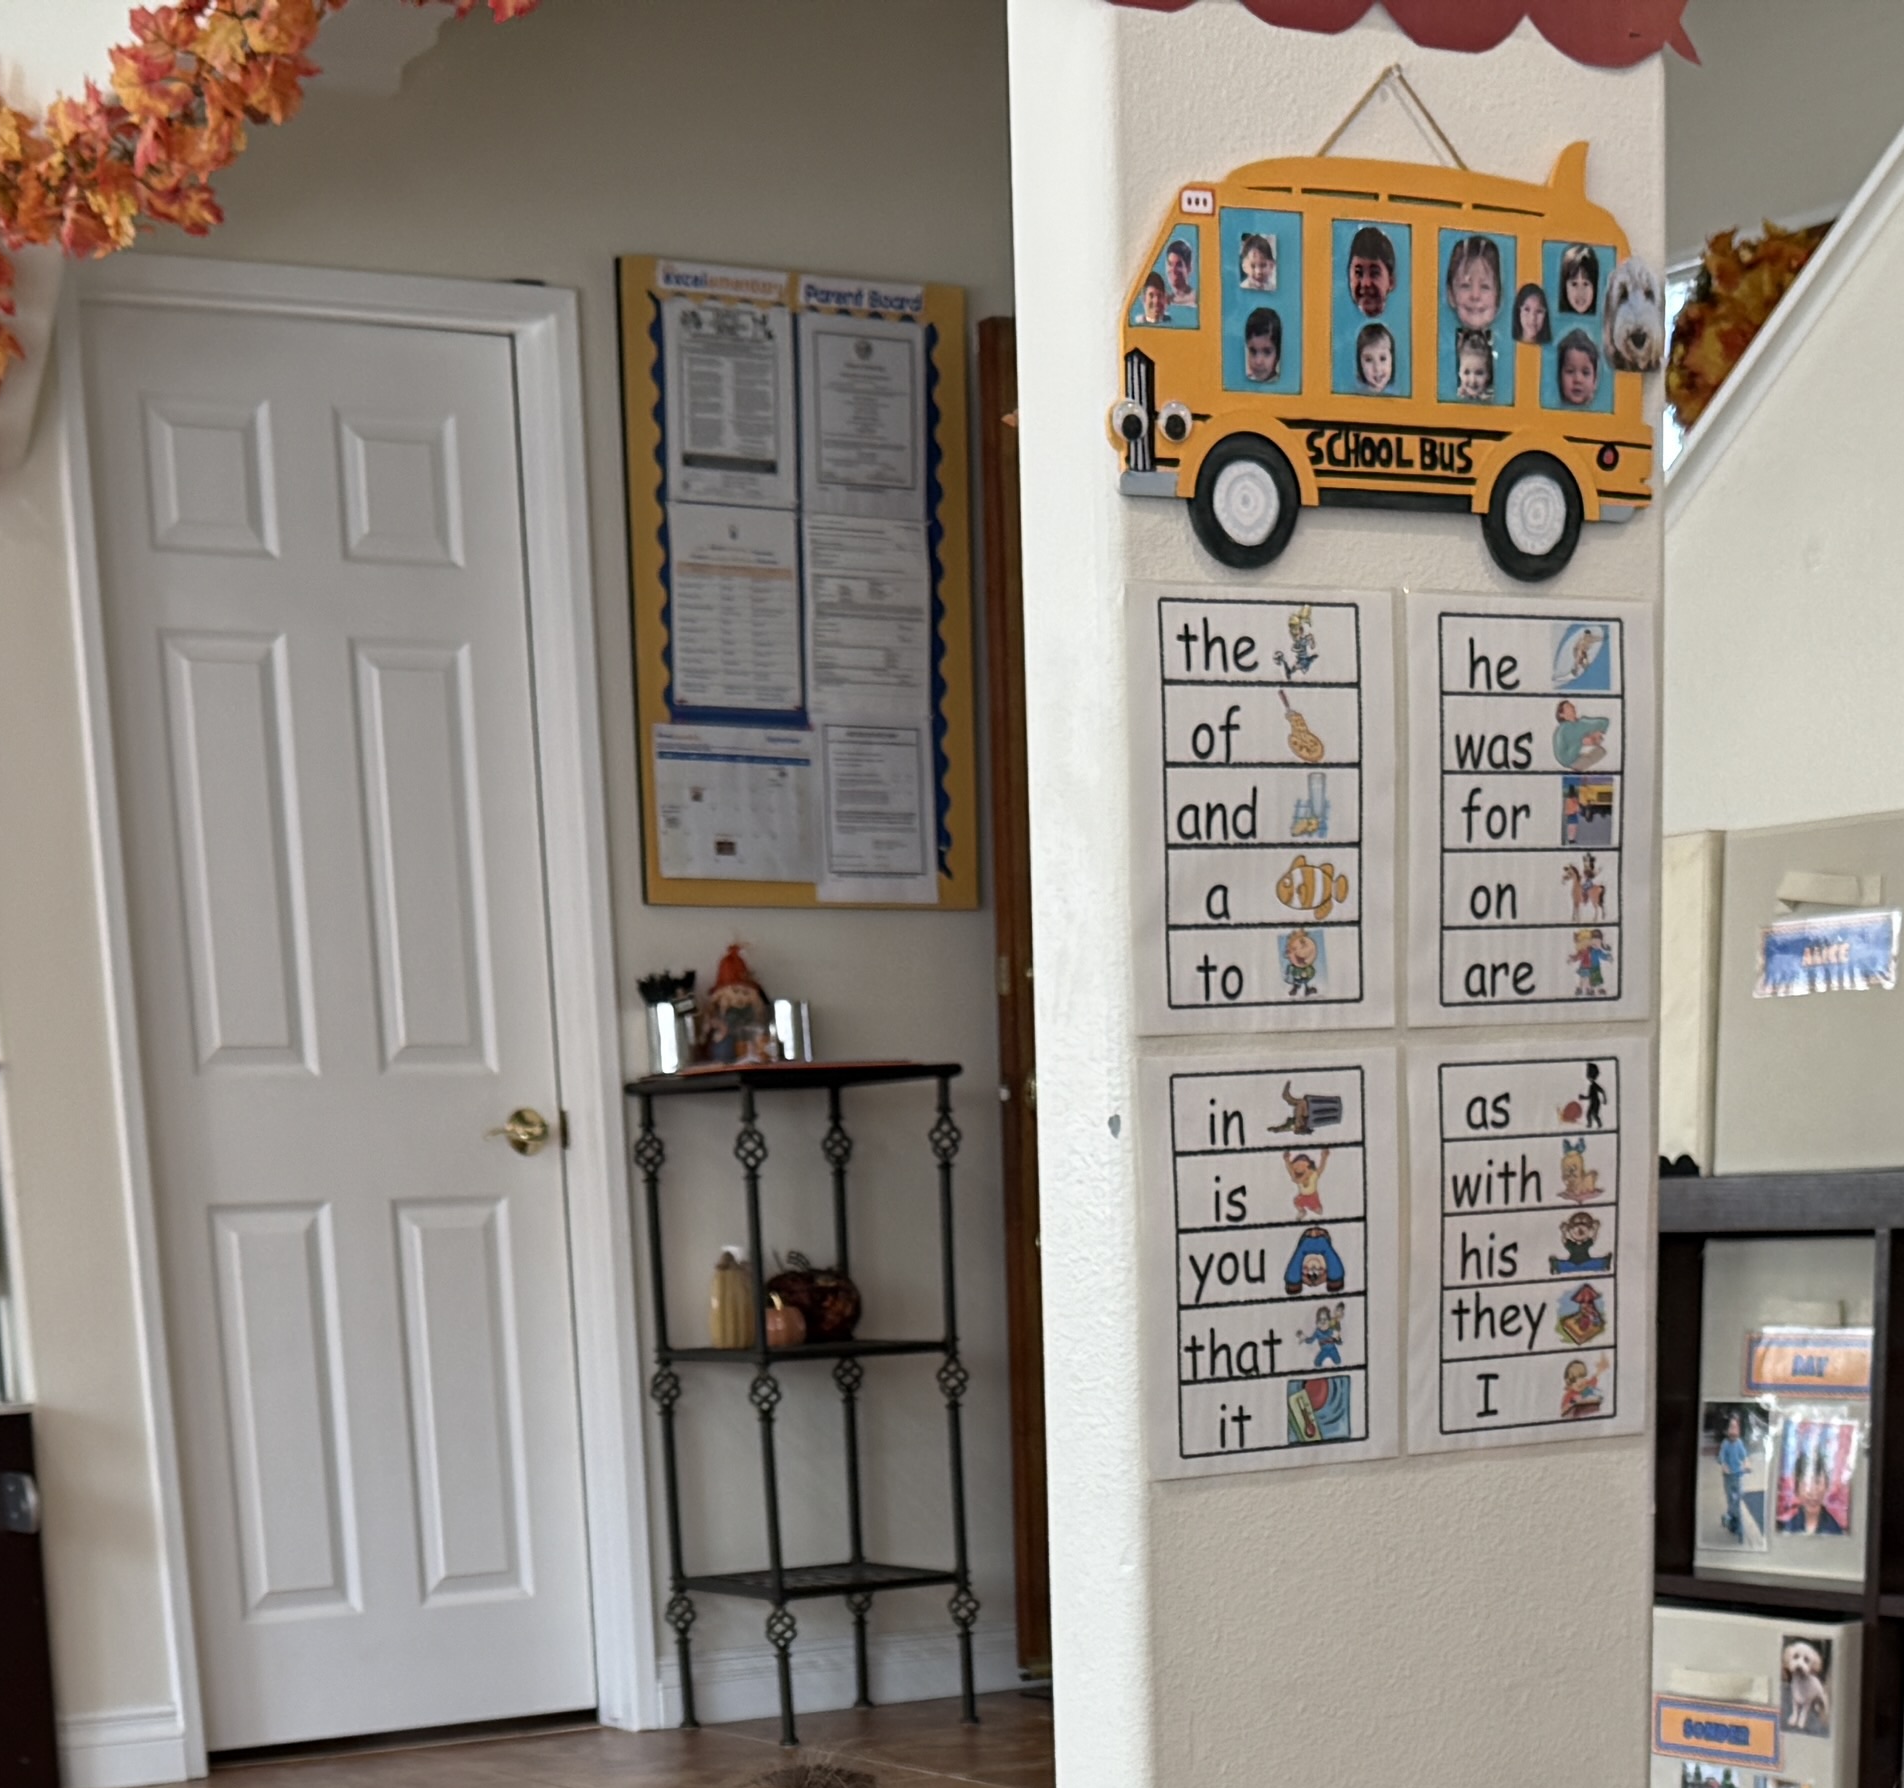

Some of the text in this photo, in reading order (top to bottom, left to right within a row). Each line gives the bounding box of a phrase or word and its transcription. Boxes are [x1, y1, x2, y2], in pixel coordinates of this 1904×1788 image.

[1306, 429, 1473, 474] SCHOOL BUS
[1177, 617, 1259, 673] the
[1469, 638, 1520, 691] he
[1191, 707, 1240, 761] of
[1456, 730, 1533, 770] was
[1177, 787, 1258, 840] and
[1461, 787, 1531, 842] for
[1206, 884, 1231, 920] a
[1470, 878, 1517, 919] on
[1197, 955, 1244, 1001] to
[1465, 959, 1536, 998] are
[1208, 1100, 1245, 1147] in
[1466, 1090, 1511, 1130] as
[1213, 1178, 1247, 1223] is
[1452, 1155, 1541, 1209] with
[1189, 1248, 1266, 1301] you
[1461, 1232, 1518, 1280] his
[1452, 1293, 1547, 1352] they
[1184, 1329, 1282, 1377] that
[1477, 1373, 1499, 1418] I
[1219, 1407, 1252, 1449] it
